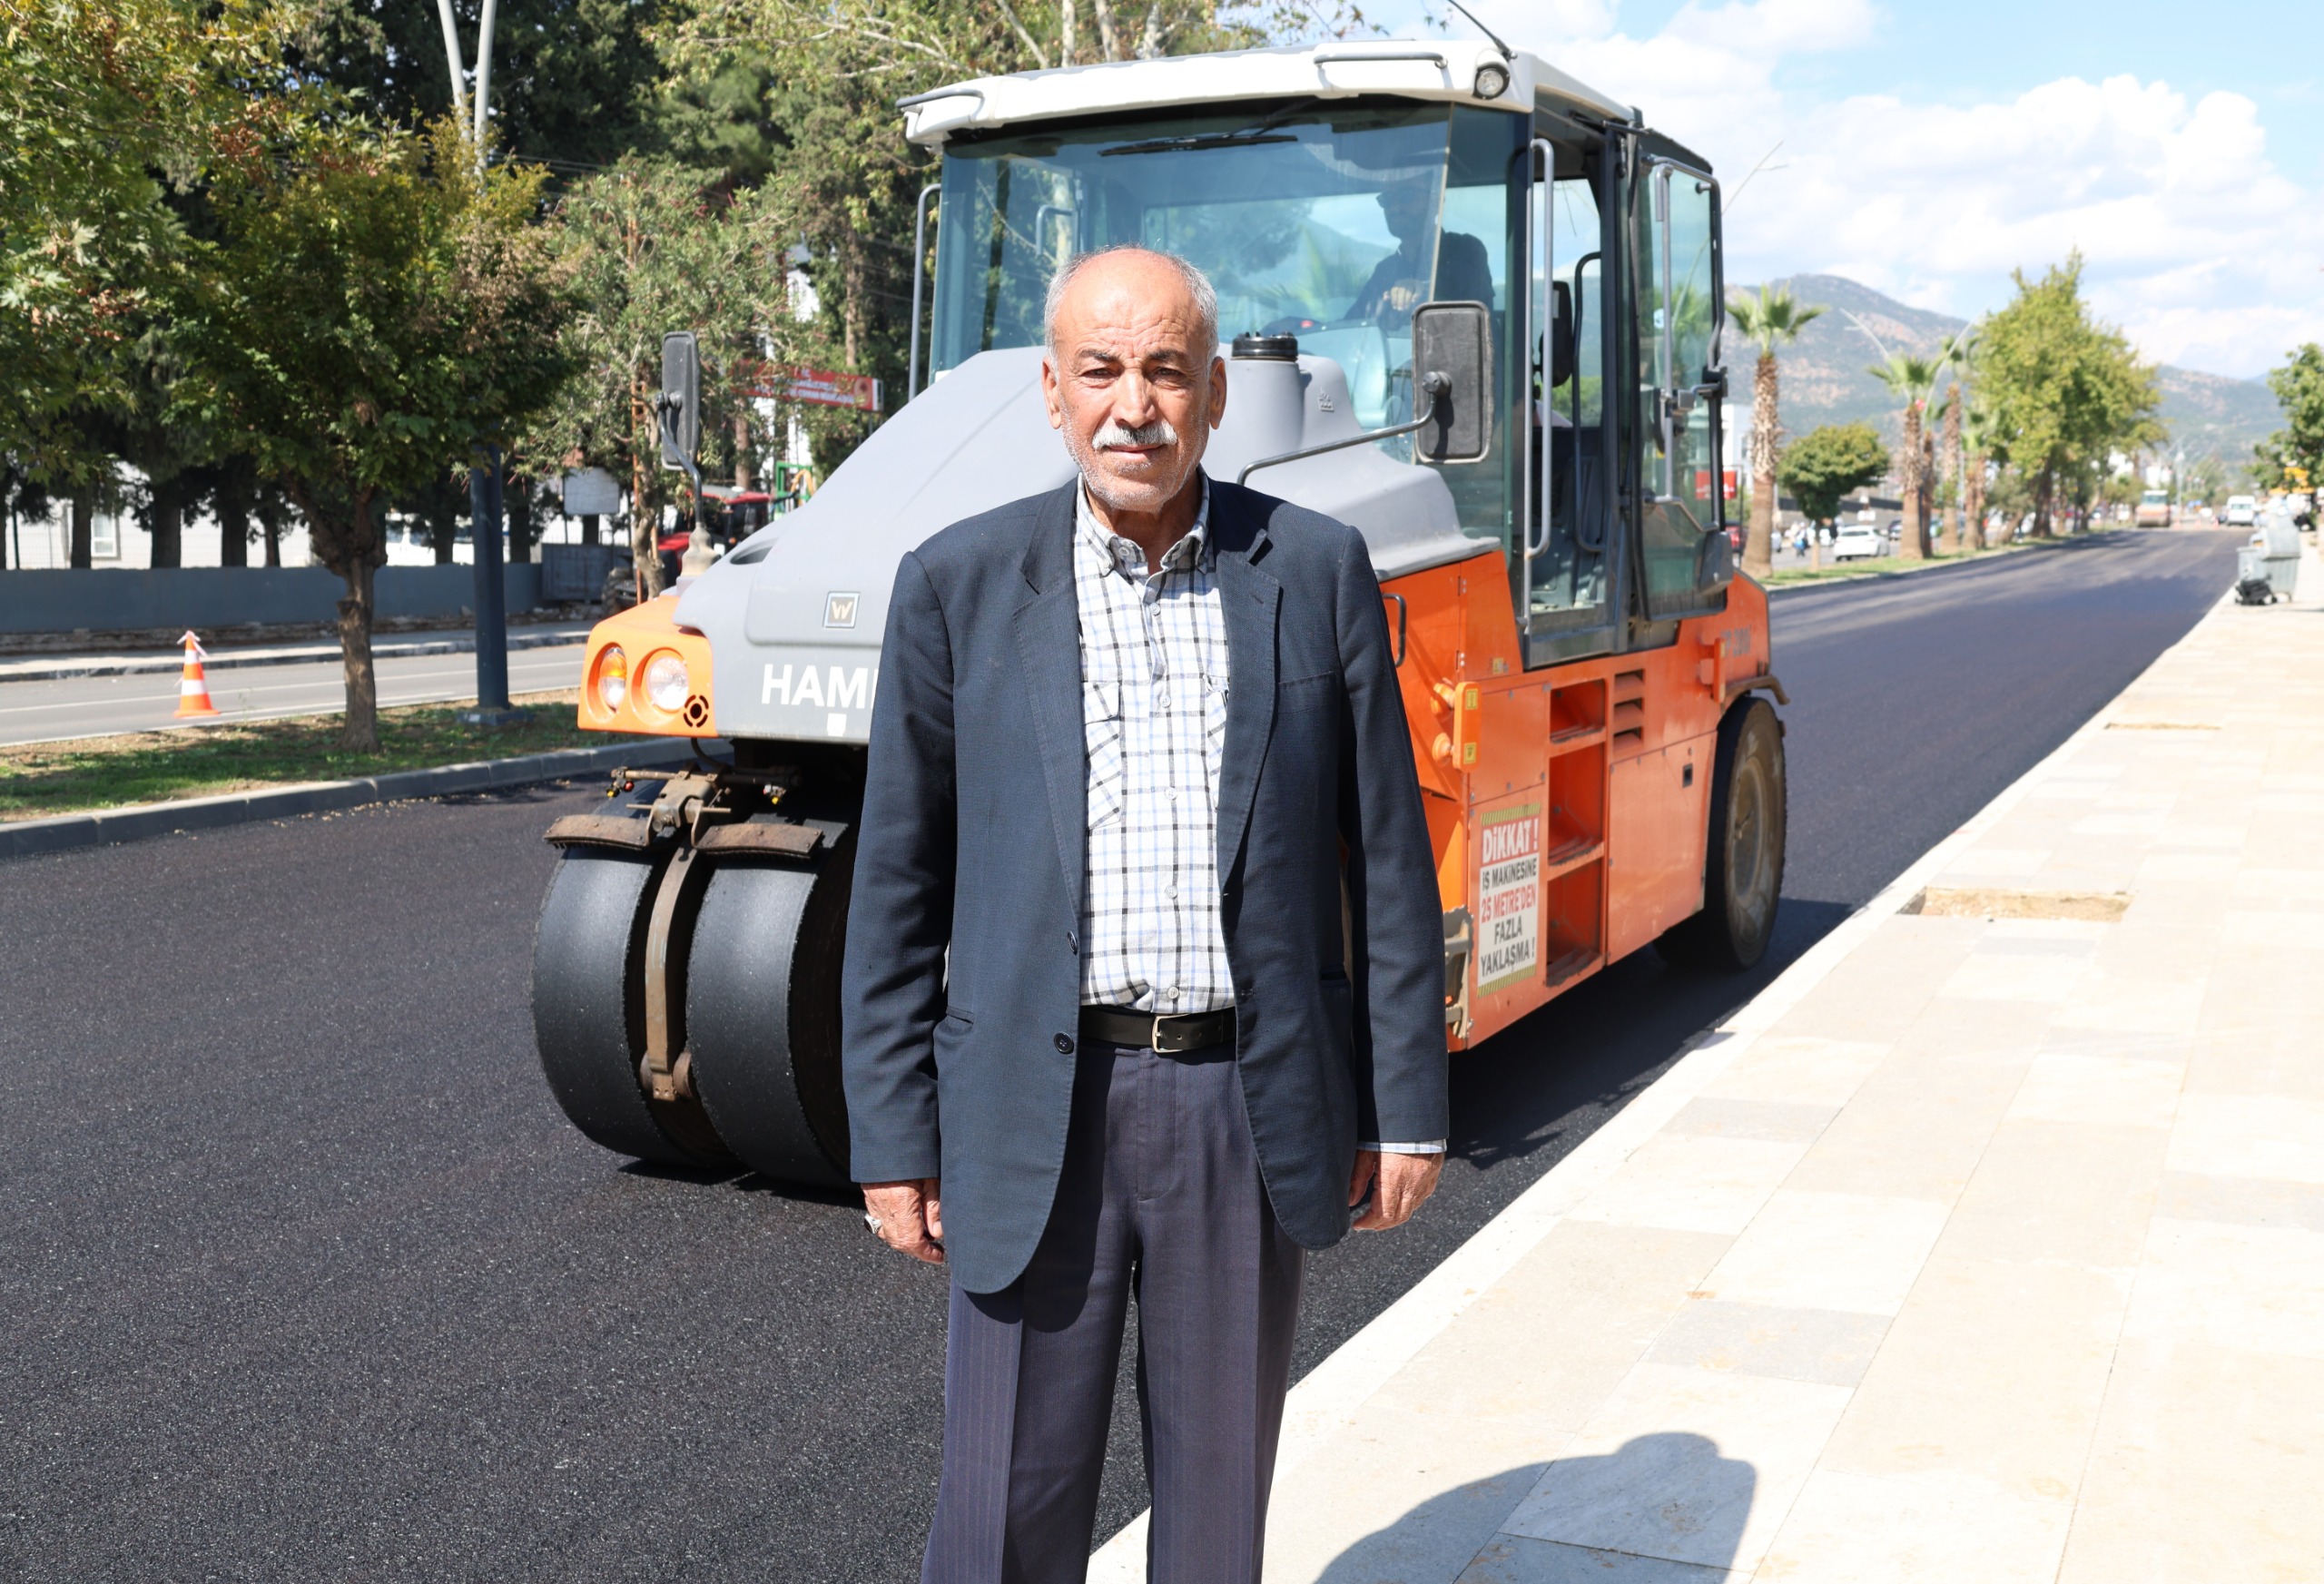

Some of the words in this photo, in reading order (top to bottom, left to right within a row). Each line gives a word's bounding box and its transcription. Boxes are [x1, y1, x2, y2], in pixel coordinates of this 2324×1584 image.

[761, 664, 879, 710] HAM
[1481, 896, 1492, 923] 25
[1494, 915, 1522, 945] FAZLA
